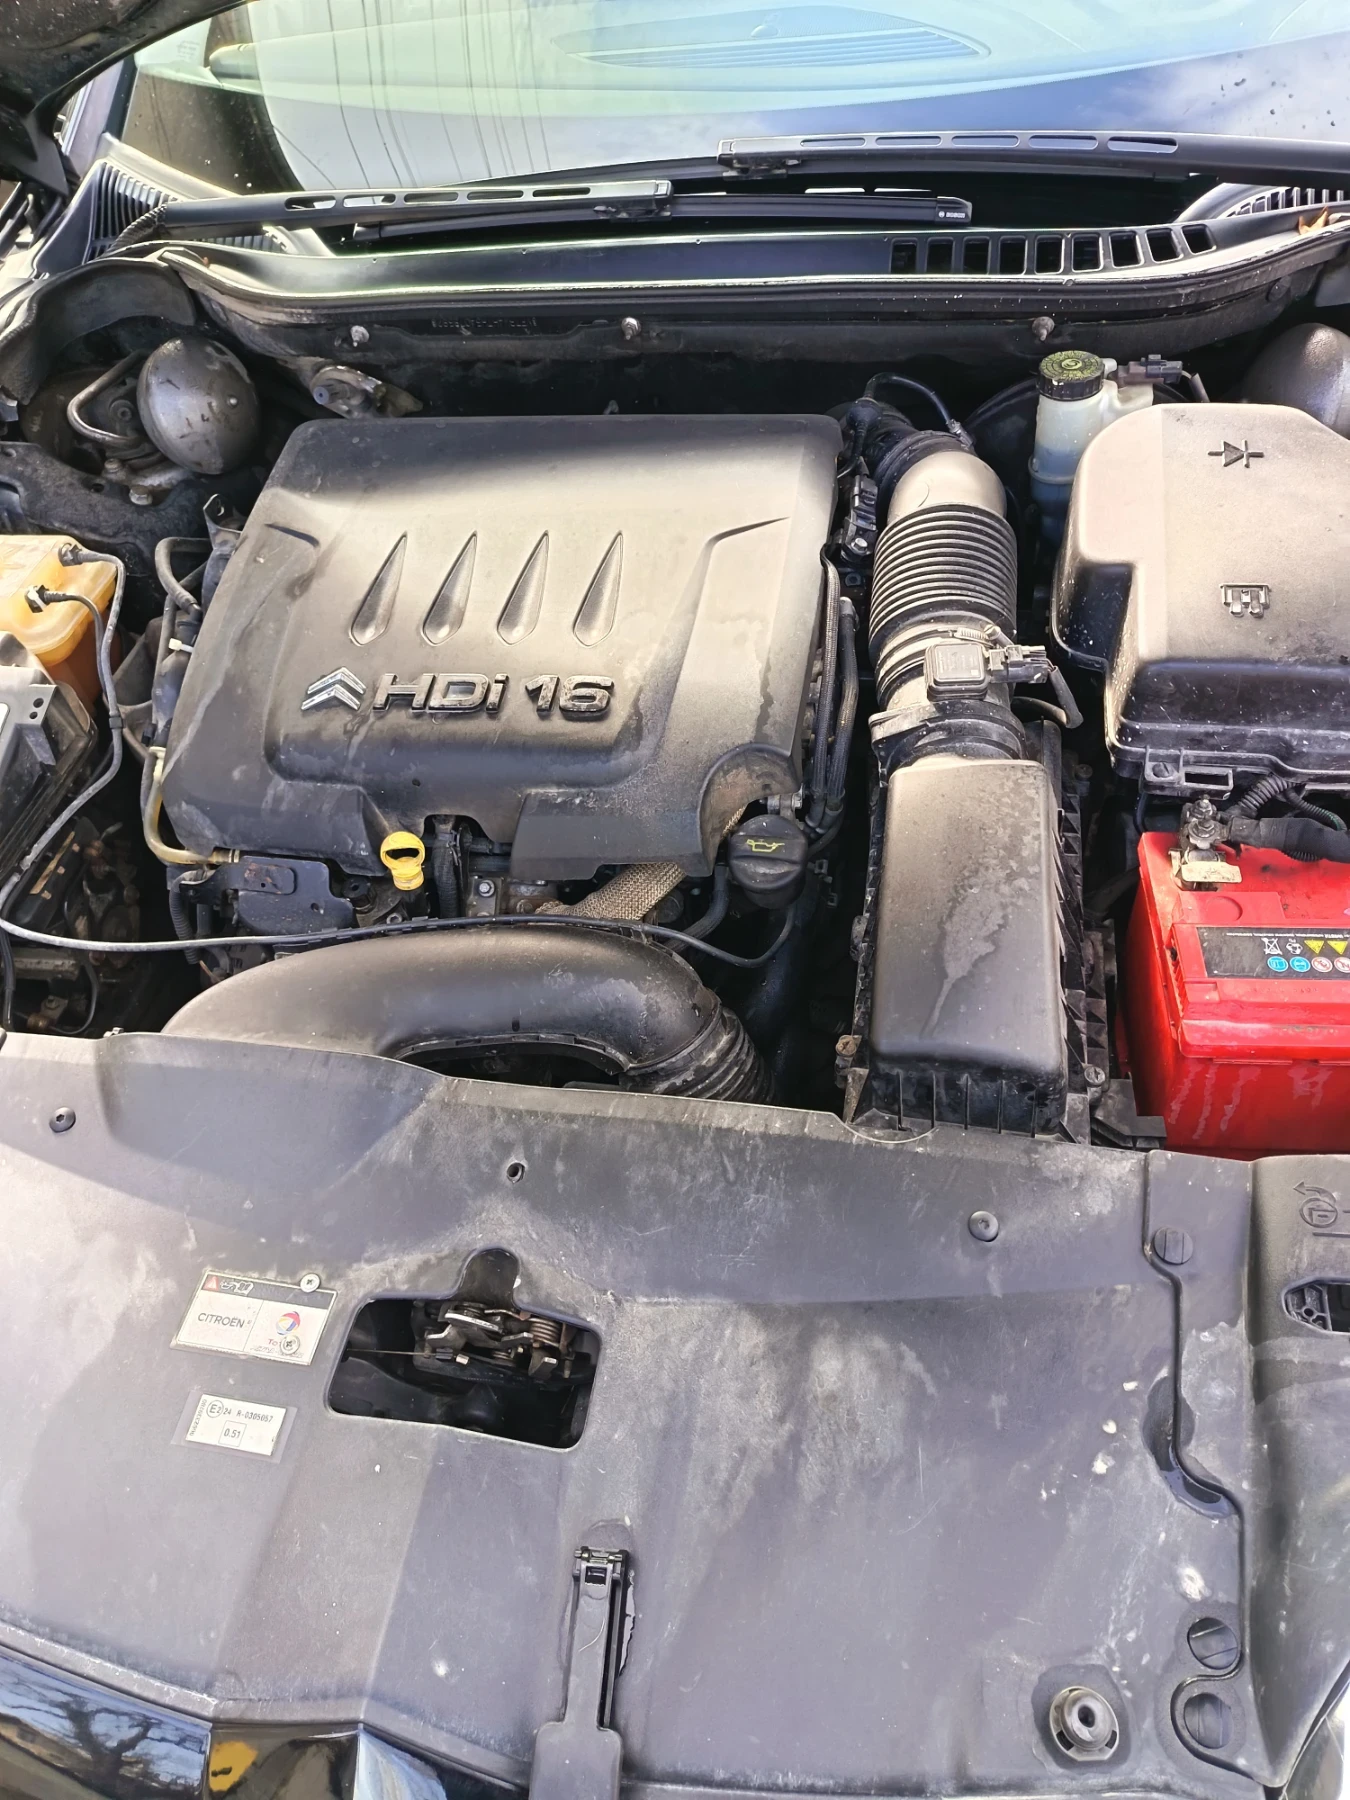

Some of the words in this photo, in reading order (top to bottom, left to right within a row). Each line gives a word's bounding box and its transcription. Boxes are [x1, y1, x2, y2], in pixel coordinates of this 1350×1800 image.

[372, 673, 509, 713] HDi
[525, 674, 615, 720] 16
[197, 1312, 246, 1329] CITROËN
[222, 1407, 232, 1416] 24
[223, 1427, 242, 1440] 0.51
